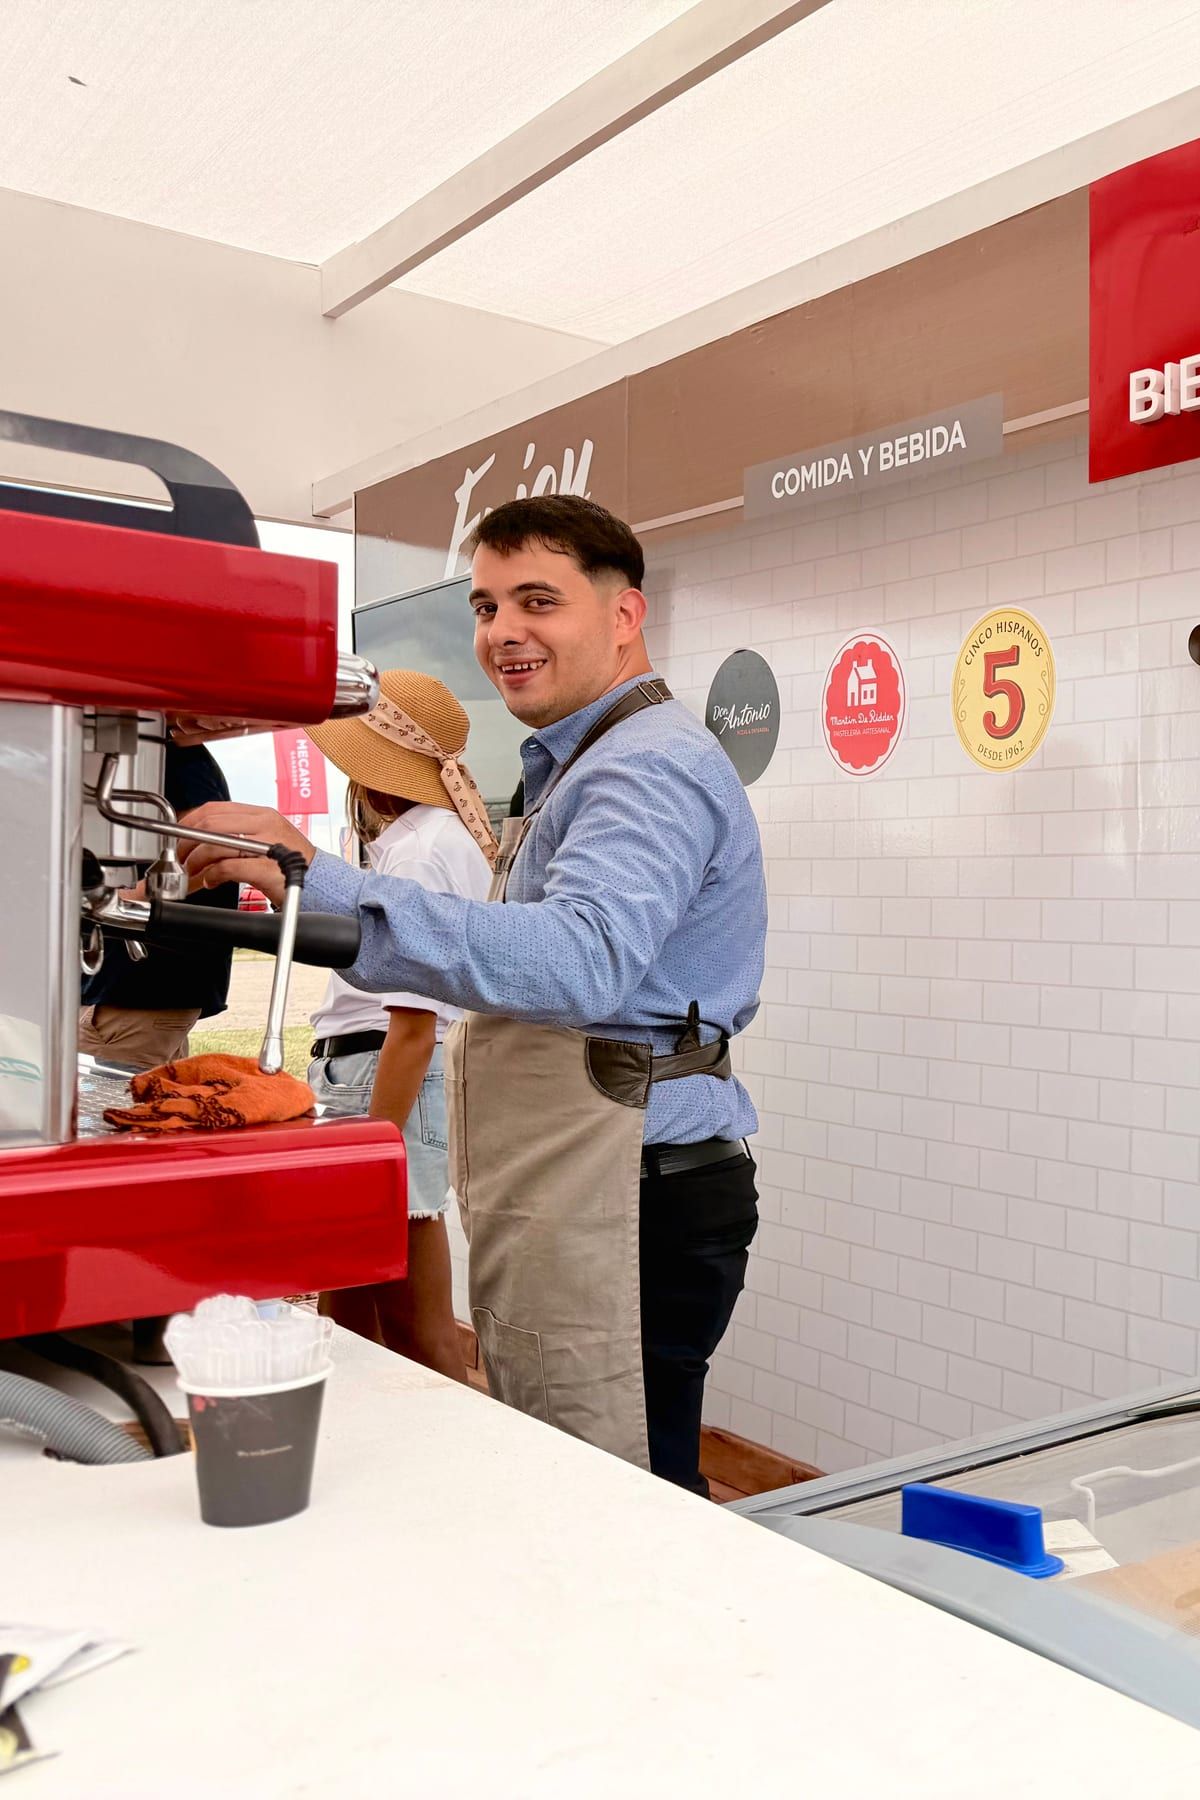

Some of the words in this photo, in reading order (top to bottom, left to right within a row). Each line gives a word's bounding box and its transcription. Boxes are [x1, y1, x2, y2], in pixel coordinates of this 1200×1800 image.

[771, 452, 854, 499] COMIDA
[857, 445, 874, 476] Y
[879, 419, 967, 472] BEBIDA
[964, 627, 993, 666] CINCO
[996, 620, 1044, 657] HISPANOS
[982, 644, 1026, 740] 5
[713, 705, 729, 721] Don
[719, 703, 771, 735] Antonio
[858, 712, 868, 724] De
[296, 739, 312, 799] MECANO
[977, 743, 1003, 761] DESDE
[1005, 739, 1025, 760] 1962
